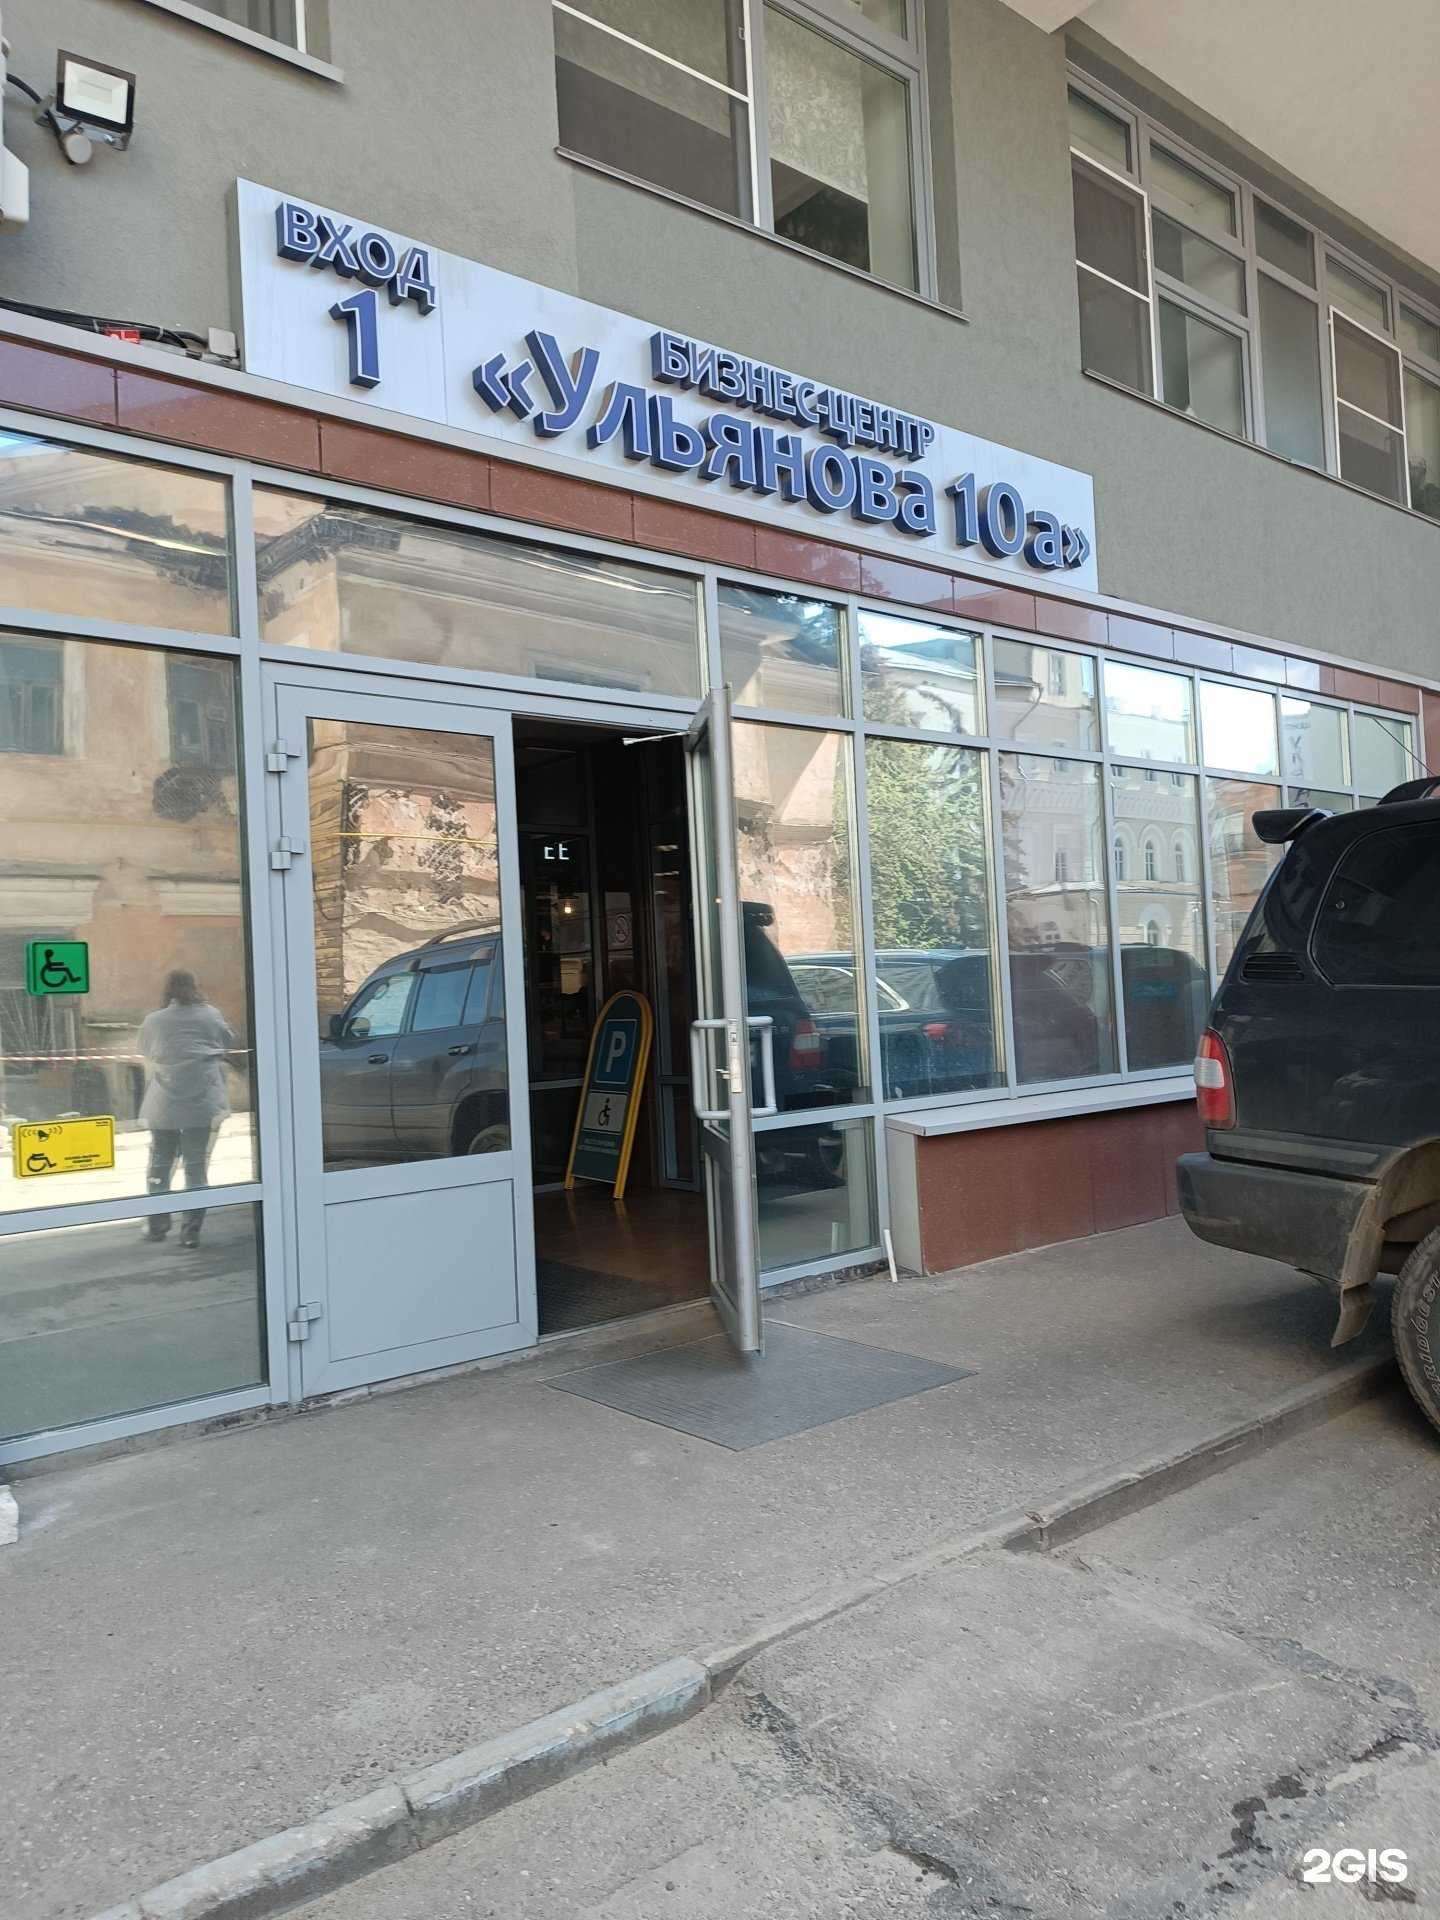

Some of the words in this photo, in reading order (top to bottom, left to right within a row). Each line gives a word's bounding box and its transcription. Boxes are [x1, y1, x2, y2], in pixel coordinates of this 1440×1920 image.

[276, 202, 436, 316] ВХОД
[328, 289, 381, 389] 1
[650, 331, 935, 461] БИЗНЕС-ЦЕНТР
[472, 329, 936, 537] «Ульянова
[945, 472, 1090, 570] 10а»
[606, 1031, 626, 1072] P
